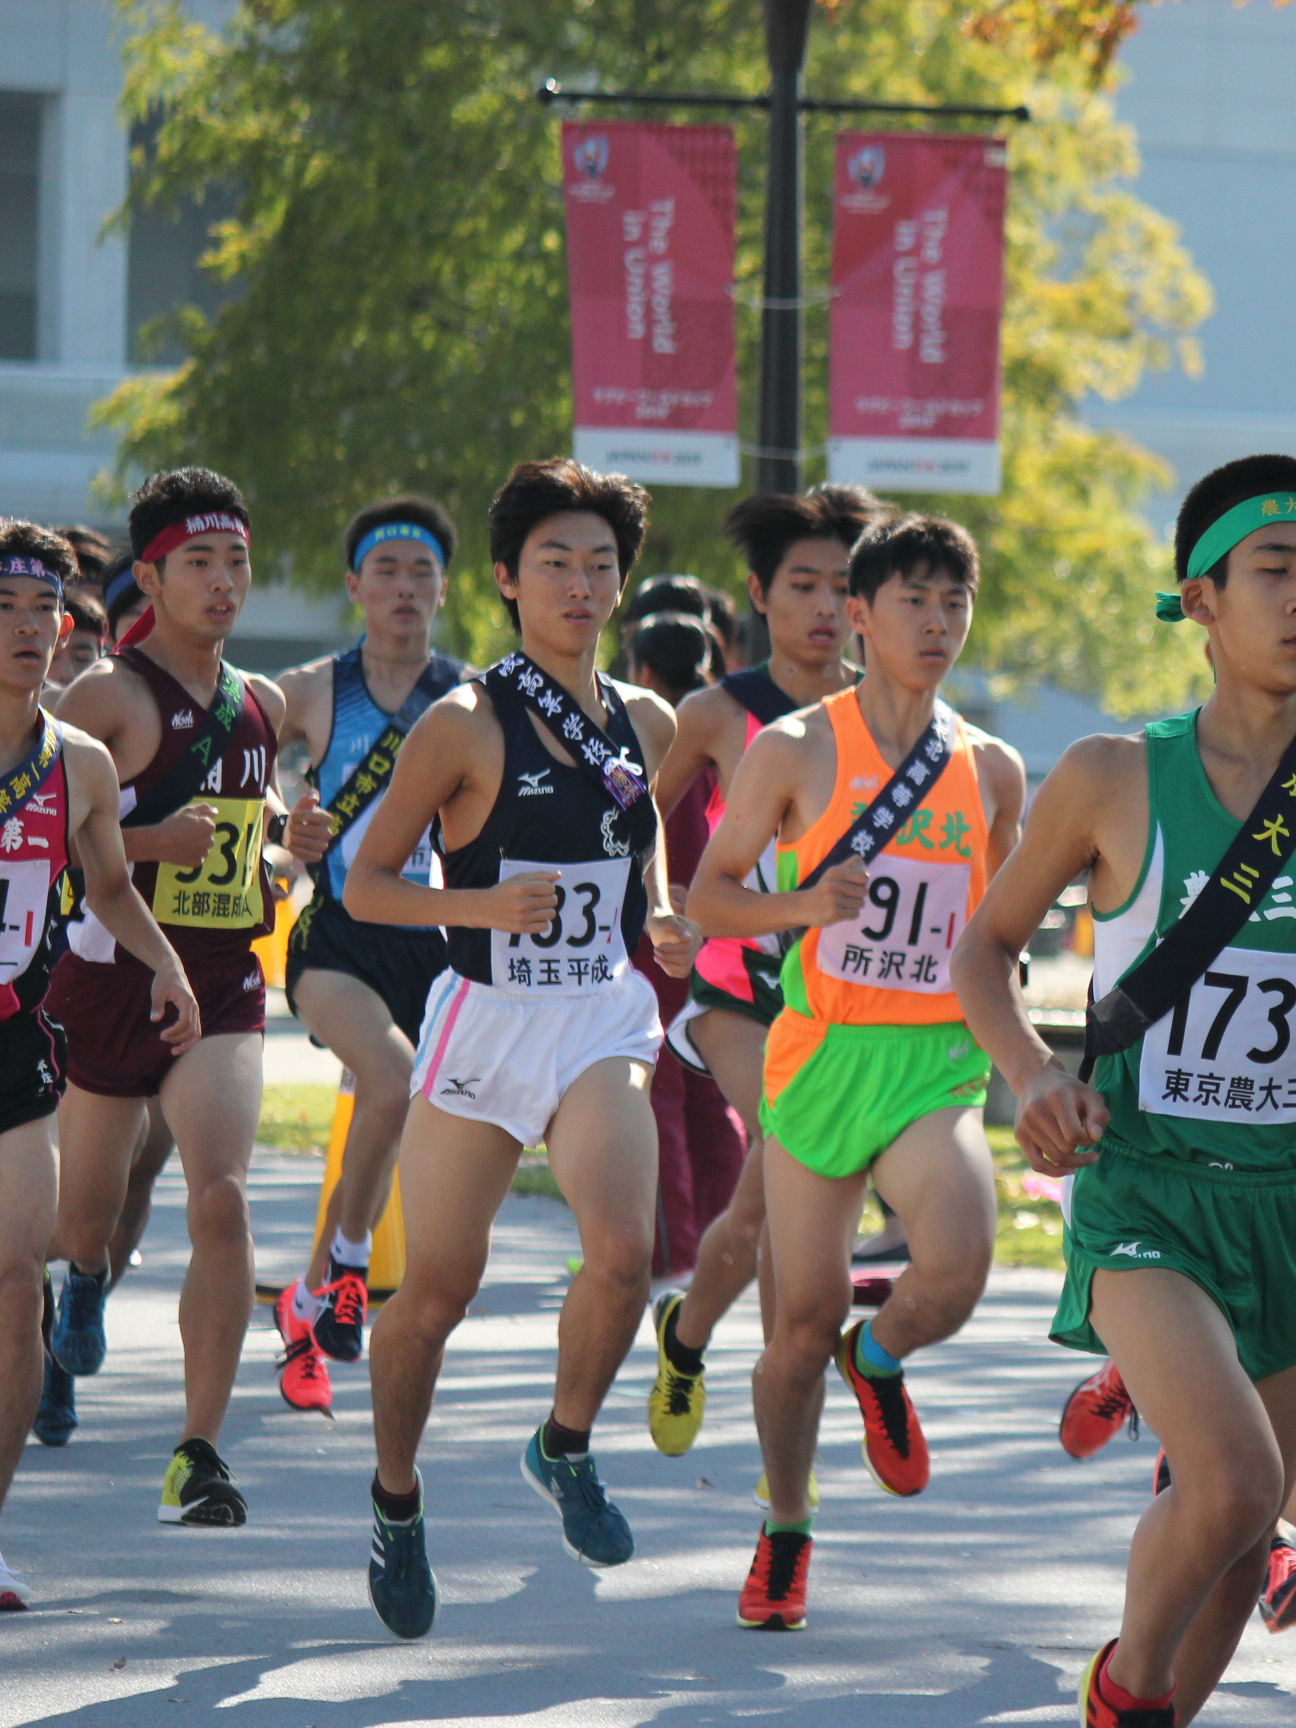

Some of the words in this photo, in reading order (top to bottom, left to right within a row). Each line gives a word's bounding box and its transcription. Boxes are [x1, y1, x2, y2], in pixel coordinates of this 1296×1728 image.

[622, 209, 647, 242] in
[650, 196, 676, 256] The
[894, 219, 920, 252] in
[921, 207, 949, 265] The
[623, 246, 648, 339] Union
[650, 260, 678, 355] World
[892, 255, 920, 350] Union
[919, 268, 950, 364] World
[25, 804, 57, 817] MIZUNO
[518, 785, 554, 797] MIZUNO
[850, 802, 973, 858] 沢北
[508, 954, 614, 988] 埼玉平成
[841, 945, 939, 984] 所沢北
